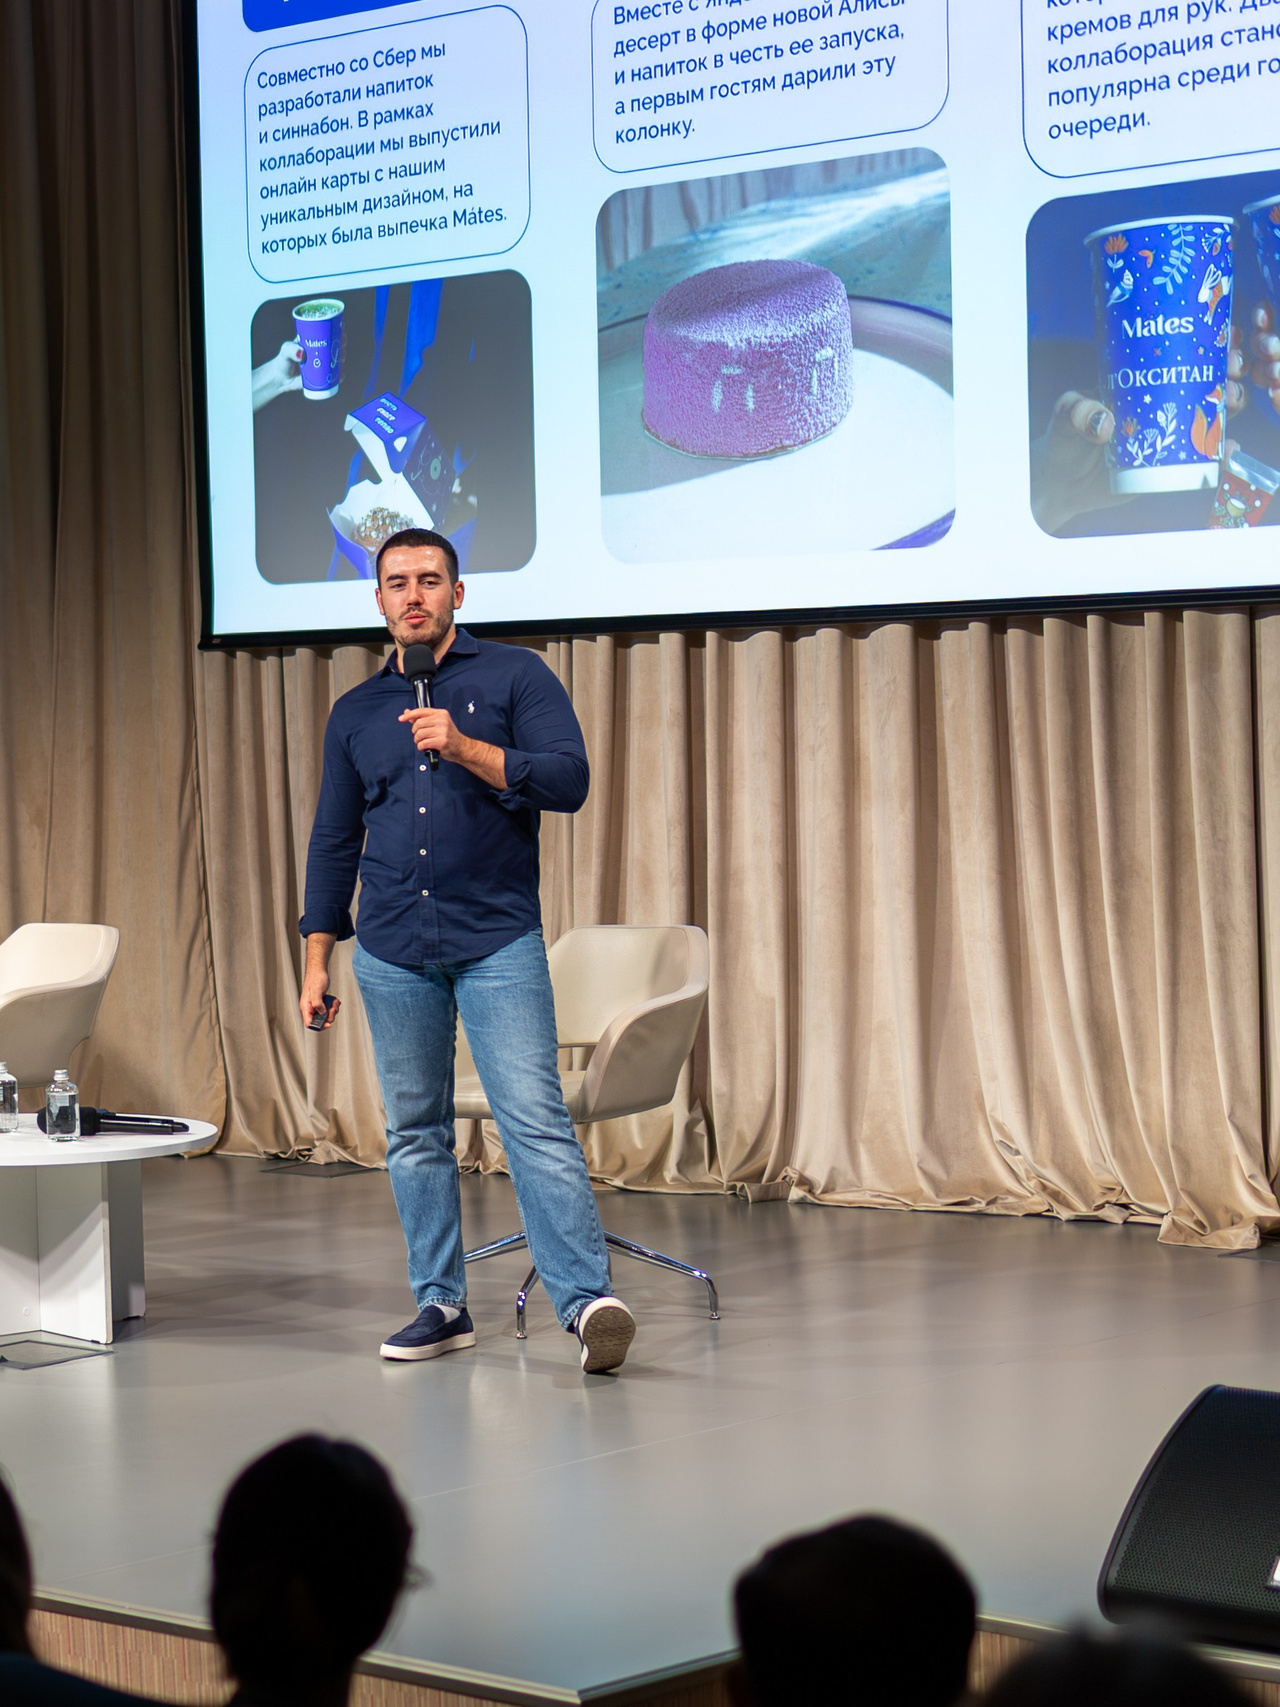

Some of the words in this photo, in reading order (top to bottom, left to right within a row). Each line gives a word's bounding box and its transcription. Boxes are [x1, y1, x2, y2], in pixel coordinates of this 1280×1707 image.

[613, 30, 681, 59] десерт
[686, 27, 696, 43] в
[701, 15, 767, 44] форме
[773, 0, 833, 28] новой
[614, 0, 683, 25] Вместе
[1047, 13, 1132, 45] кремов
[1138, 5, 1179, 30] для
[1187, 0, 1232, 25] рук.
[257, 61, 345, 89] Совместно
[349, 57, 369, 73] со
[373, 47, 416, 68] Сбер
[421, 43, 445, 60] мы
[615, 70, 625, 85] и
[631, 56, 708, 83] напиток
[714, 53, 724, 69] в
[729, 44, 784, 65] честь
[789, 38, 814, 56] ее
[819, 23, 904, 51] запуска,
[1048, 34, 1213, 74] коллаборация
[258, 86, 361, 122] разработали
[366, 74, 434, 99] напиток
[615, 100, 625, 115] а
[631, 87, 704, 114] первым
[710, 75, 776, 100] гостям
[781, 62, 856, 92] дарили
[862, 56, 896, 77] эту
[1048, 74, 1171, 107] популярна
[1177, 62, 1250, 92] среди
[259, 131, 268, 144] и
[272, 115, 353, 142] синнабон.
[358, 110, 369, 128] В
[373, 102, 434, 130] рамках
[615, 119, 695, 144] колонку.
[1048, 111, 1150, 140] очереди.
[259, 141, 375, 172] коллаборации
[380, 136, 404, 153] мы
[409, 120, 501, 148] выпустили
[260, 176, 317, 200] онлайн
[321, 170, 370, 192] карты
[374, 168, 384, 182] с
[388, 158, 445, 180] нашим
[260, 200, 358, 232] уникальным
[362, 187, 448, 215] дизайном,
[453, 183, 474, 199] на
[262, 233, 327, 254] которых
[331, 226, 373, 245] была
[378, 216, 448, 238] выпечка
[453, 206, 507, 228] Mátes.
